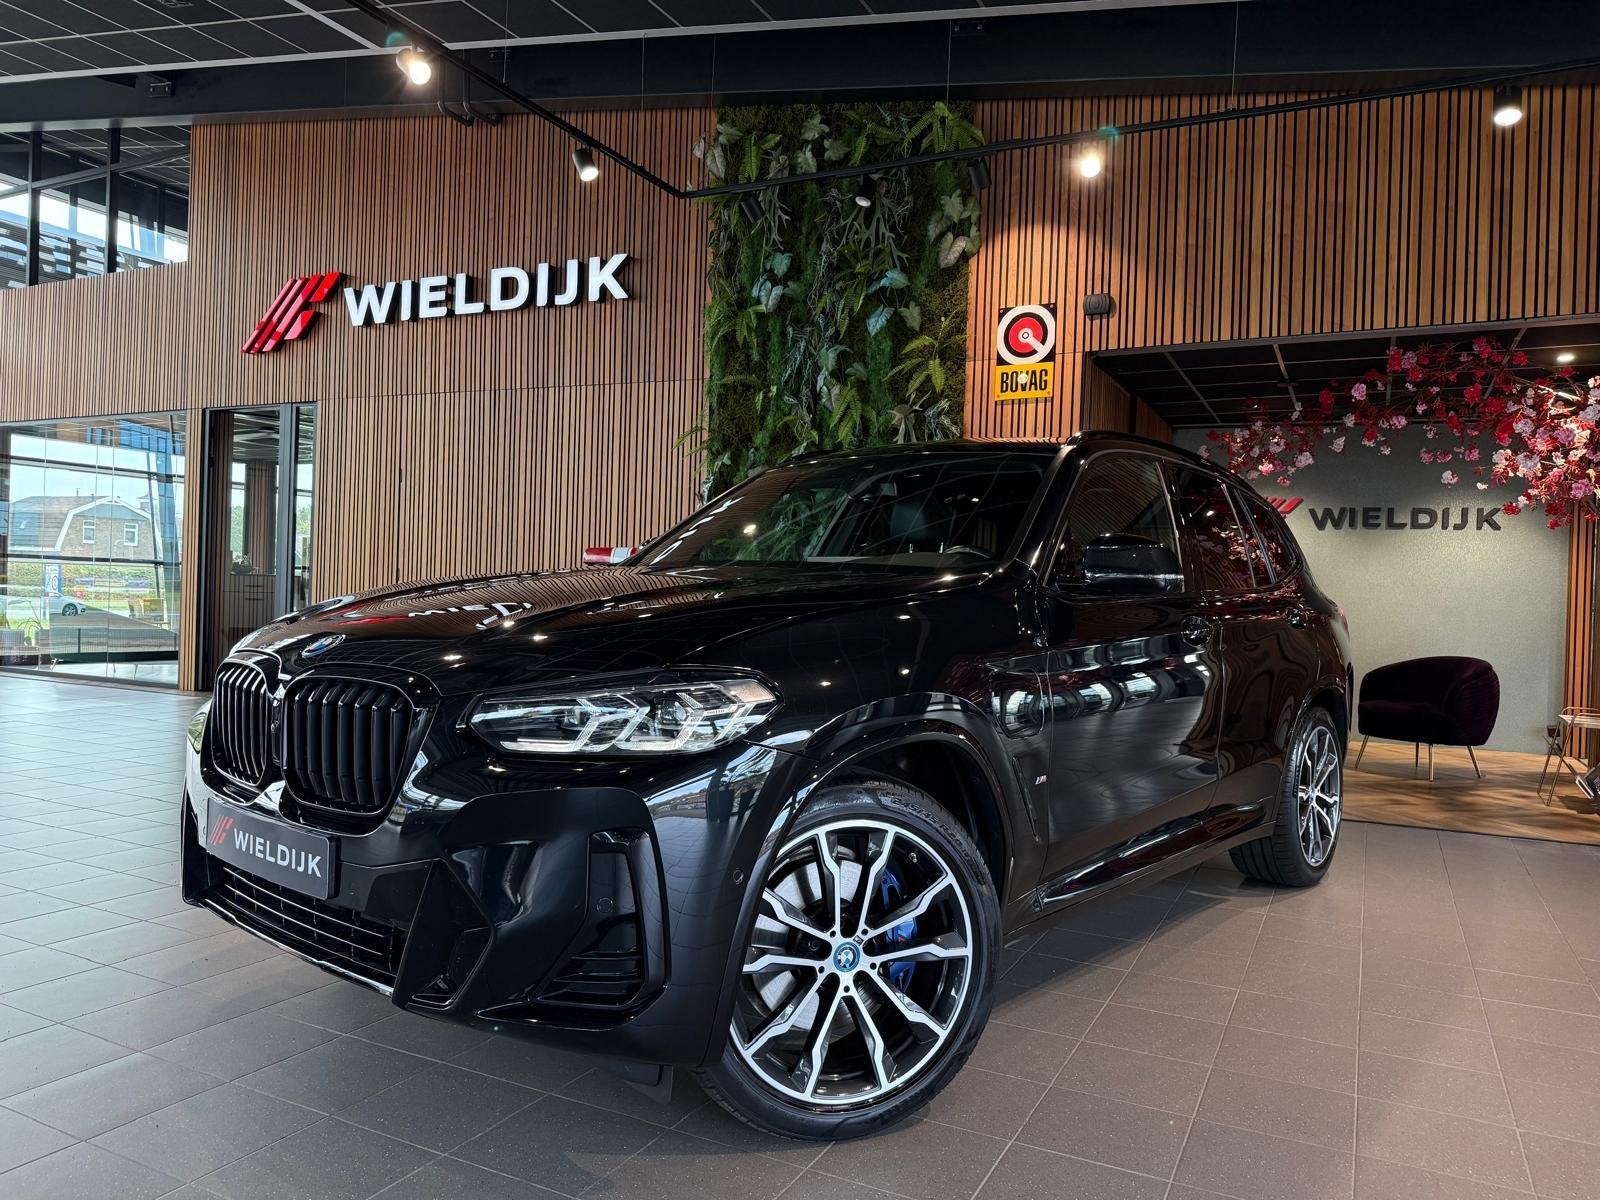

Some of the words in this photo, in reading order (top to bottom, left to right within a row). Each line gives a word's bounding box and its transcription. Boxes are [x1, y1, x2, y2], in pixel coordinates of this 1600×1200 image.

[345, 253, 628, 327] WIELDIJK
[1308, 507, 1502, 531] WIELDIJK
[233, 828, 321, 878] WIELDIJK
